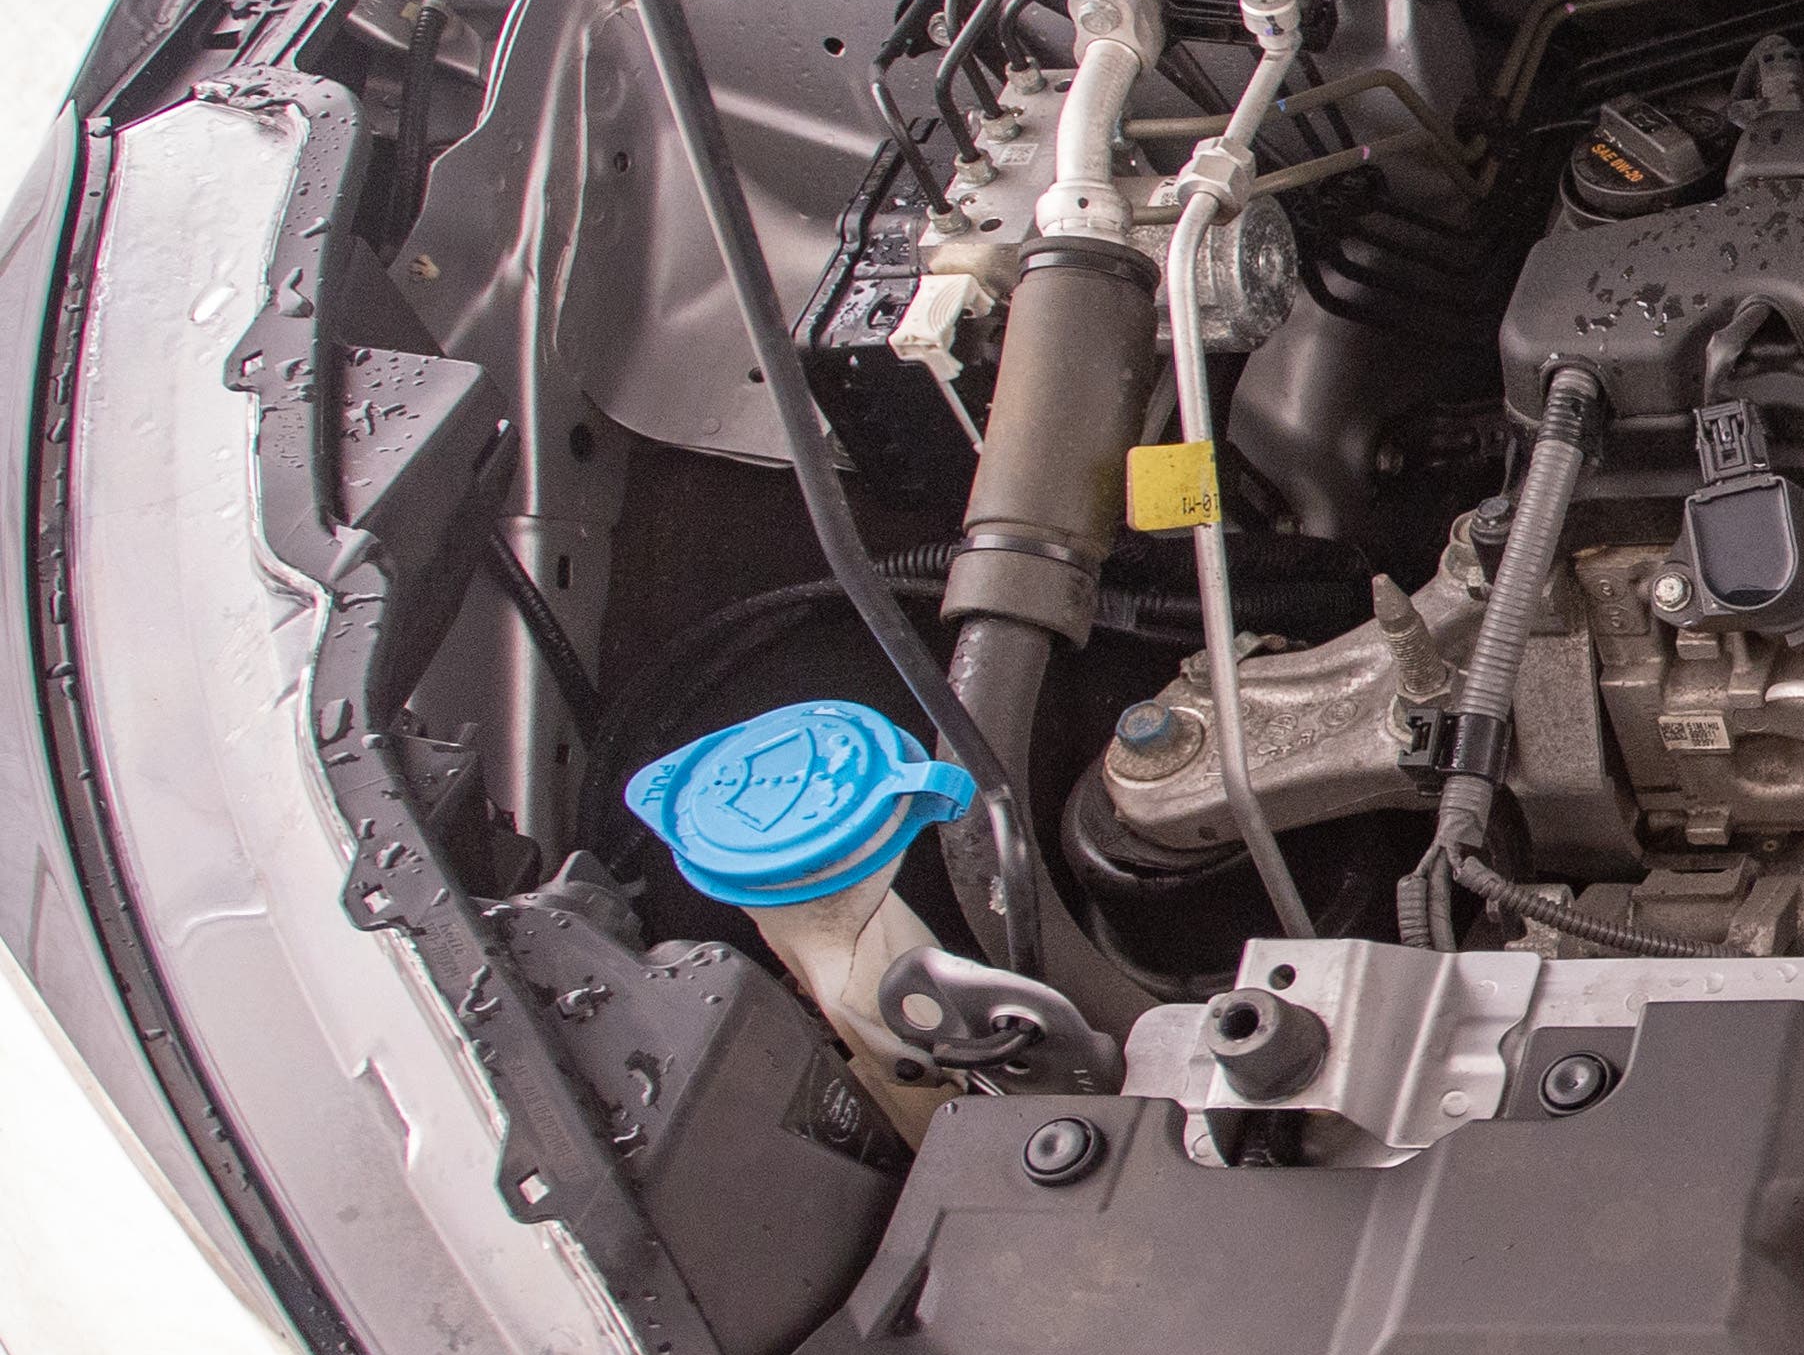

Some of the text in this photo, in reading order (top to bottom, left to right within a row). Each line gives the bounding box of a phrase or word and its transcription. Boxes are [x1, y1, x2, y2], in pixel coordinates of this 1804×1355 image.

[1591, 143, 1644, 182] SAE 0W-20
[641, 764, 676, 806] PULL
